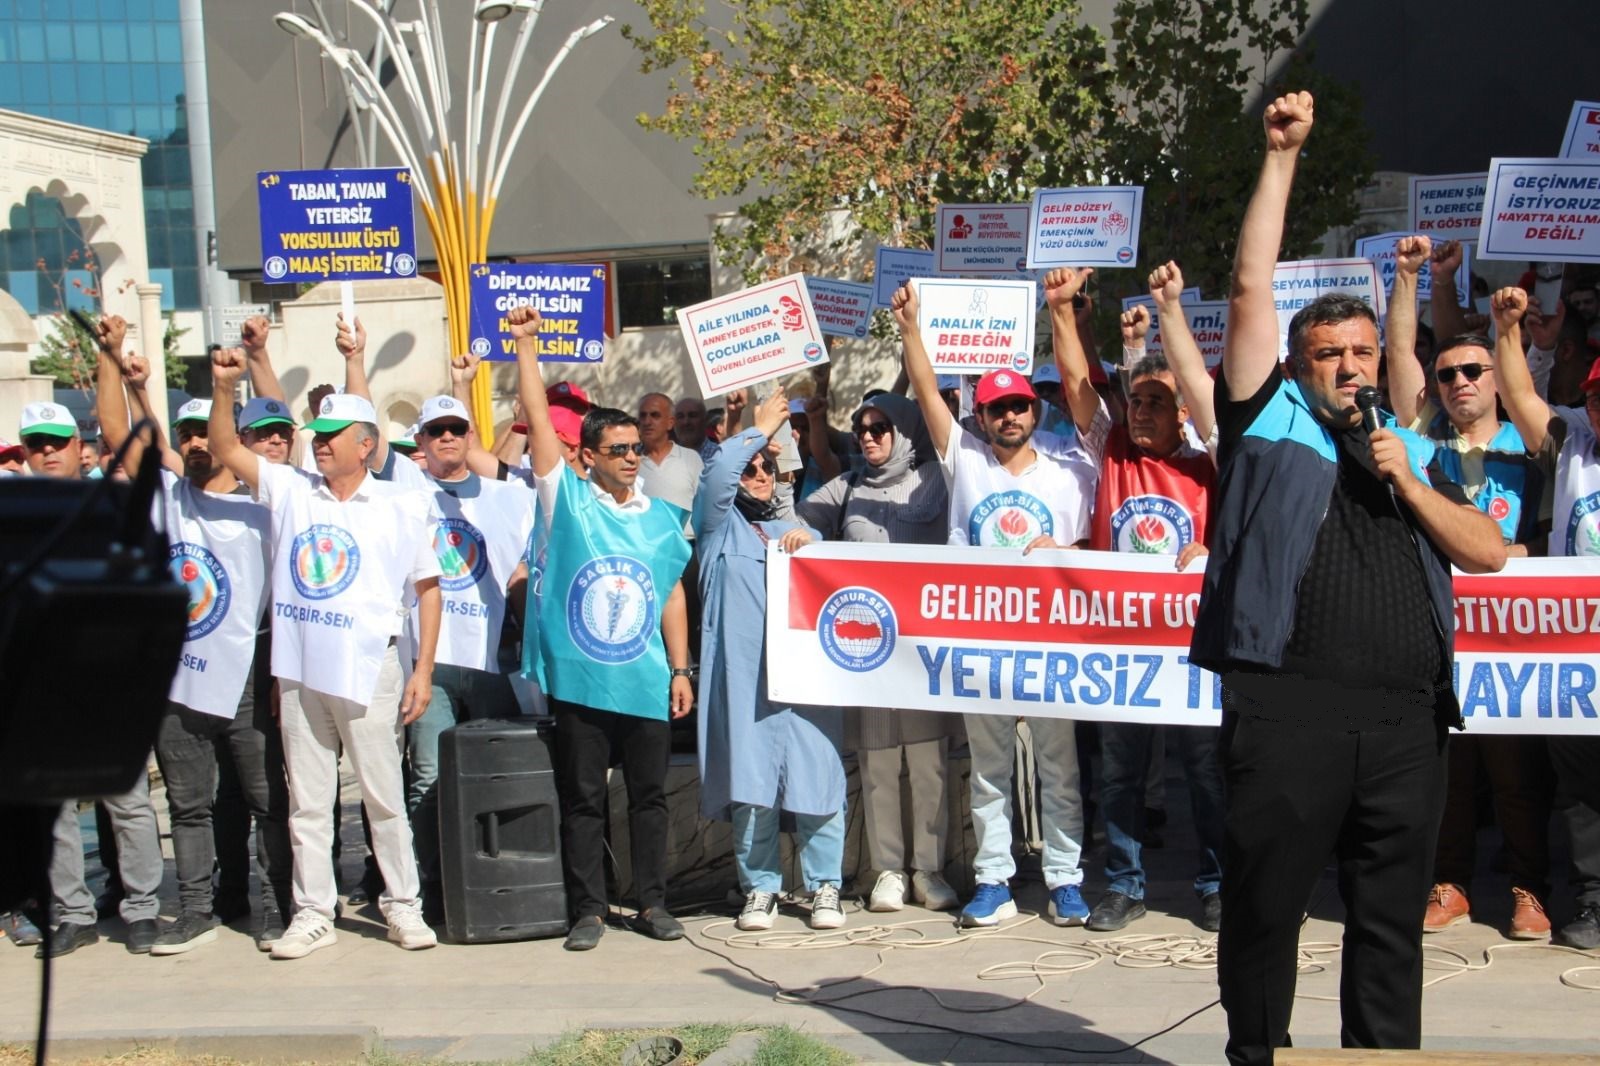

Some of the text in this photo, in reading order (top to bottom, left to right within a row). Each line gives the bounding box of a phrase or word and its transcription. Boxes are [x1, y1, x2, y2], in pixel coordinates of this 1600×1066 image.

[289, 182, 387, 203] TABAN, TAVAN
[1420, 188, 1463, 200] HEMEN
[306, 202, 373, 225] YETERSİZ
[1043, 202, 1112, 213] GELİR DÜZEYİ
[1423, 204, 1432, 215] 1.
[1041, 216, 1098, 225] ARTIRILSIN
[1418, 219, 1435, 230] EK
[1497, 213, 1554, 223] HAYATTA
[280, 226, 401, 250] YOKSULLUK ÜSTÜ
[1040, 227, 1094, 238] EMEKÇİNİN
[1524, 225, 1584, 240] DEĞİL!
[962, 245, 972, 253] BİZ
[1040, 239, 1108, 249] YÜZÜ GÜLSÜN!
[289, 255, 331, 277] MAAŞ
[489, 270, 591, 292] DİPLOMAMIZ
[1272, 276, 1369, 290] SEYYANEN ZAM
[813, 302, 865, 318] ÖNDÜRMEYE
[697, 304, 771, 334] AİLE YILINDA
[930, 316, 1016, 330] ANALIK İZNİ
[702, 319, 777, 347] ANNEYE DESTEK,
[938, 331, 1012, 347] BEBEĞİN
[706, 332, 781, 364] ÇOCUKLARA
[711, 347, 786, 375] GÜVENLİ GELECEK!
[936, 352, 1013, 365] HAKKIDIR!
[636, 571, 655, 601] SEN
[827, 592, 888, 618] MEMUR-SEN
[920, 583, 1040, 624] GELİRDE
[1048, 589, 1156, 629] ADALET
[916, 643, 1163, 708] YETERSİZ
